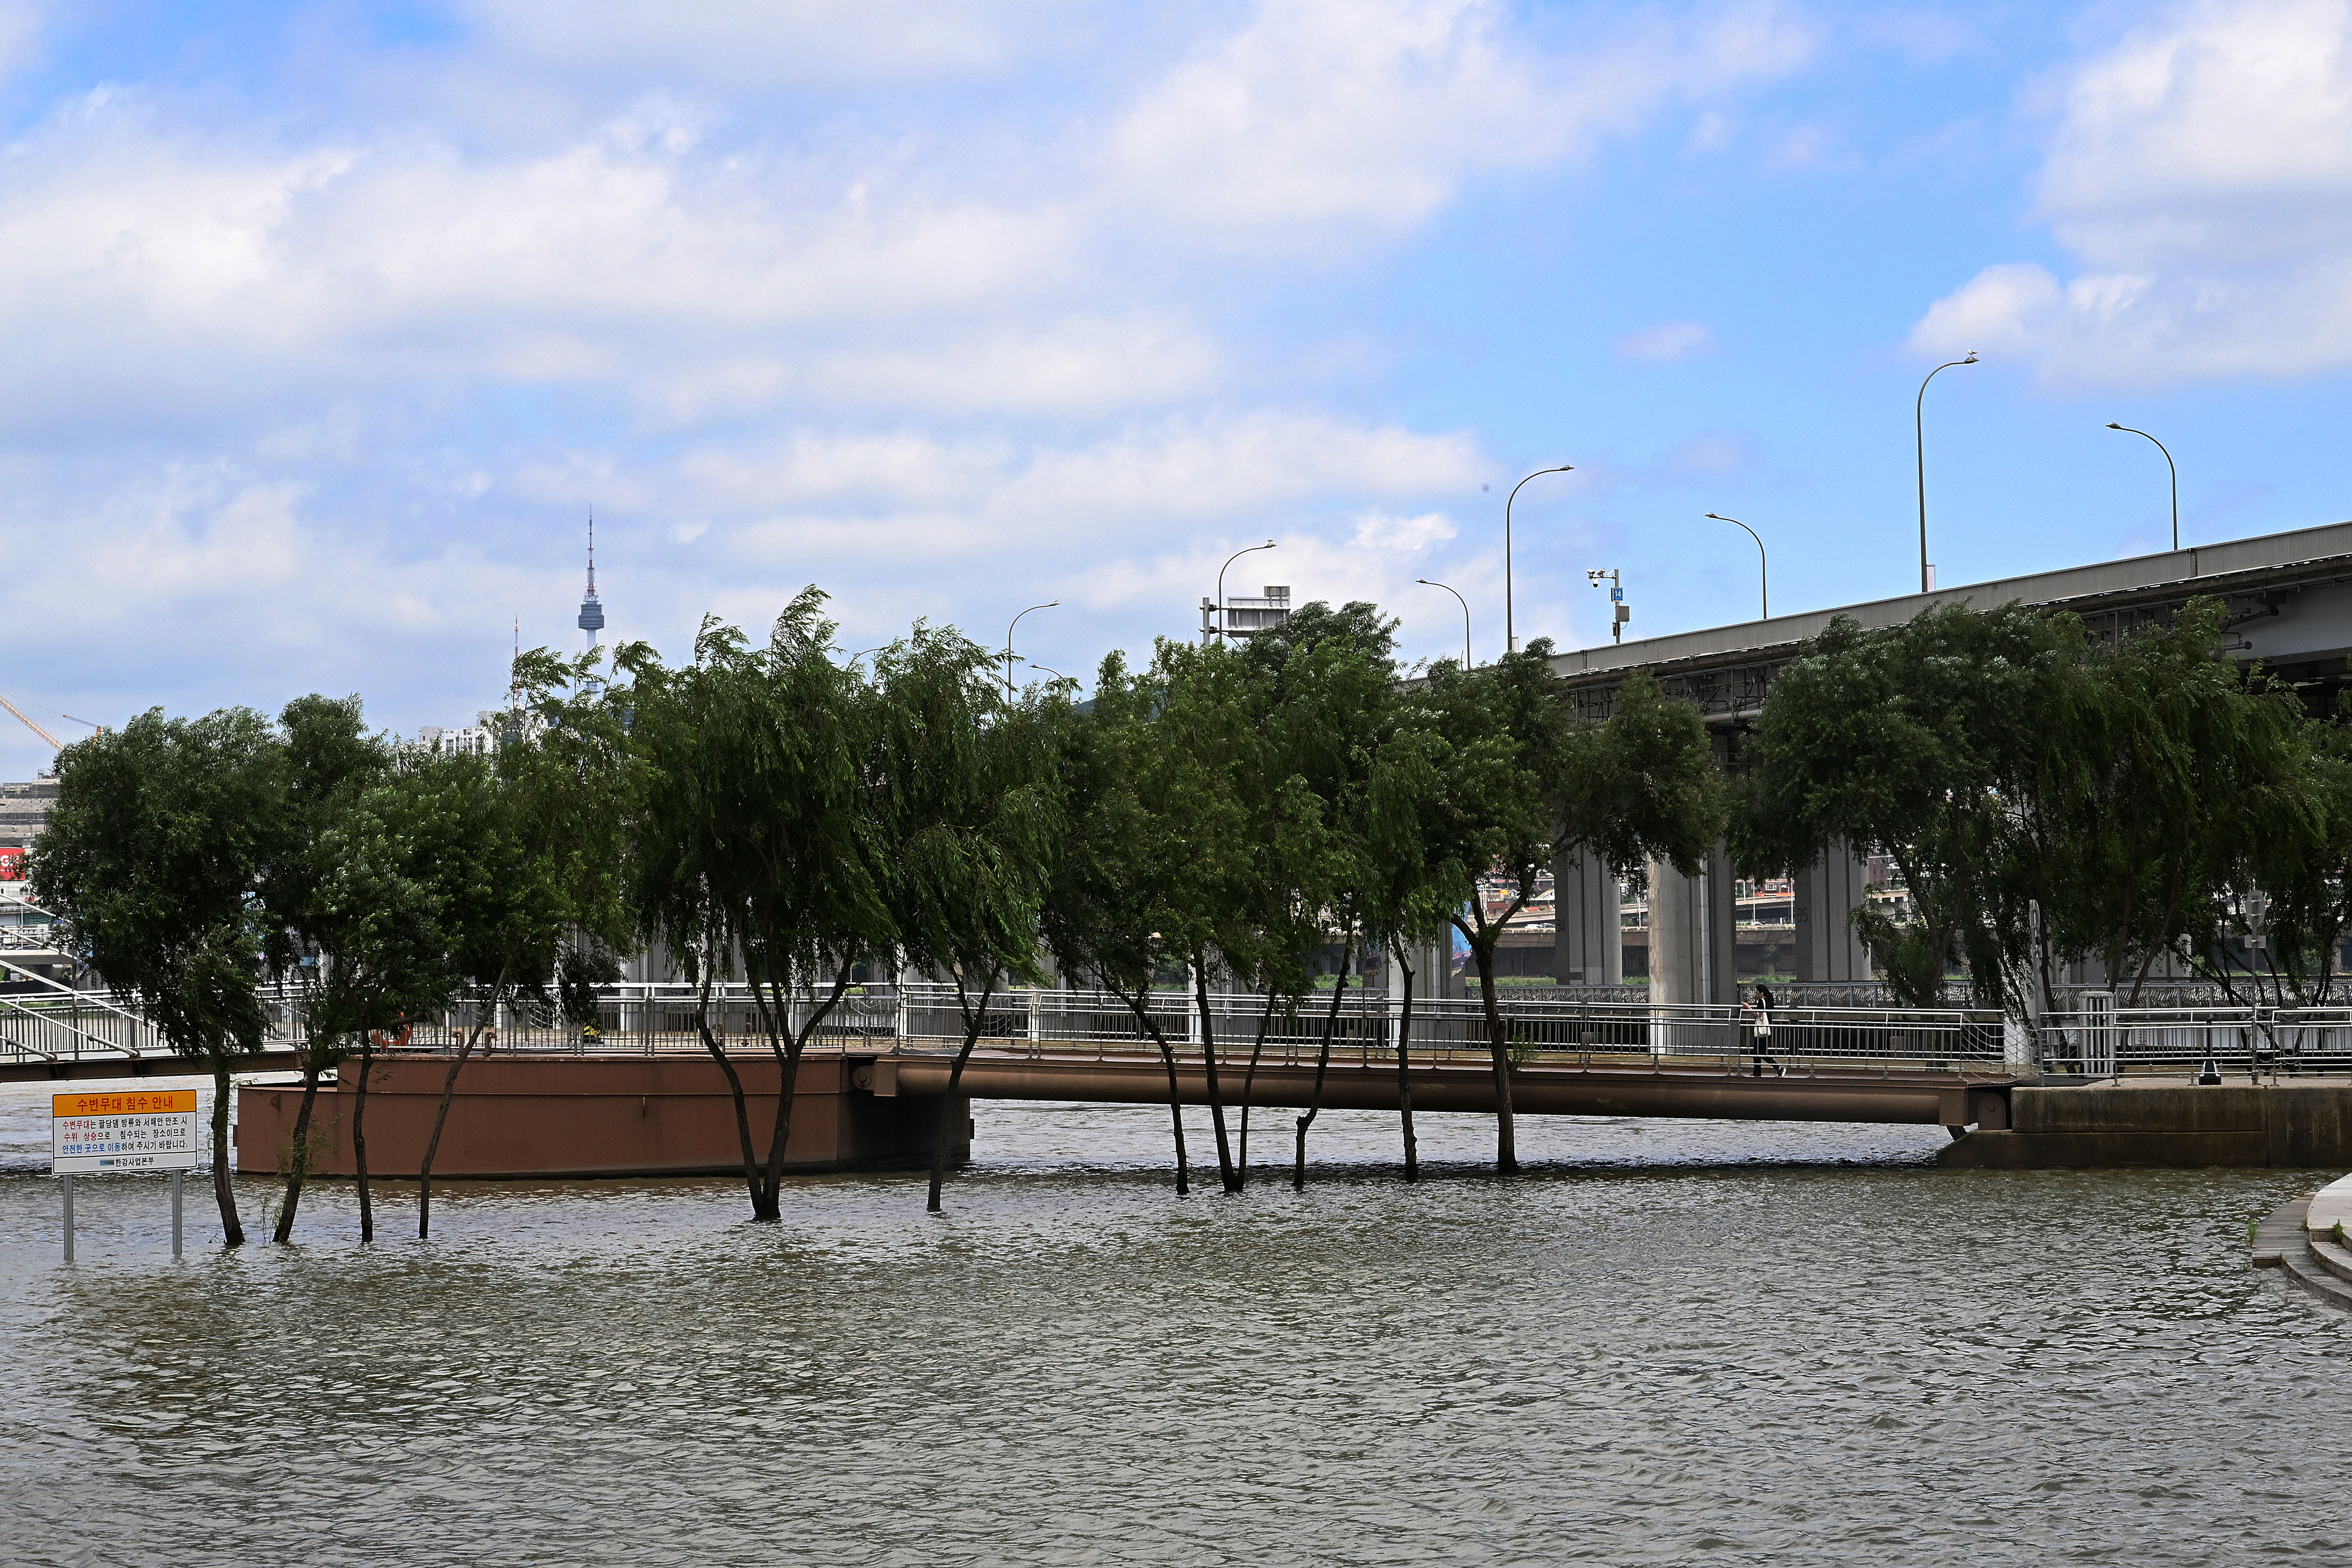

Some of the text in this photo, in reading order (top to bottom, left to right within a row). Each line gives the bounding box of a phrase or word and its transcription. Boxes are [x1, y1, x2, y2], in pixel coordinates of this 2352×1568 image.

[1798, 907, 1808, 922] 35
[1557, 918, 1566, 932] 34
[77, 1095, 173, 1112] 수변무대 침수 안내
[62, 1116, 187, 1130] 수변무대는 팔당댐 방류와 서해안 만조 시
[64, 1128, 186, 1142] 수위 상승으로 침수되는 장소이므로
[62, 1139, 188, 1154] 안전한 곳으로 이동하여 주시기 바랍니다.
[115, 1156, 154, 1167] 한강사업본부
